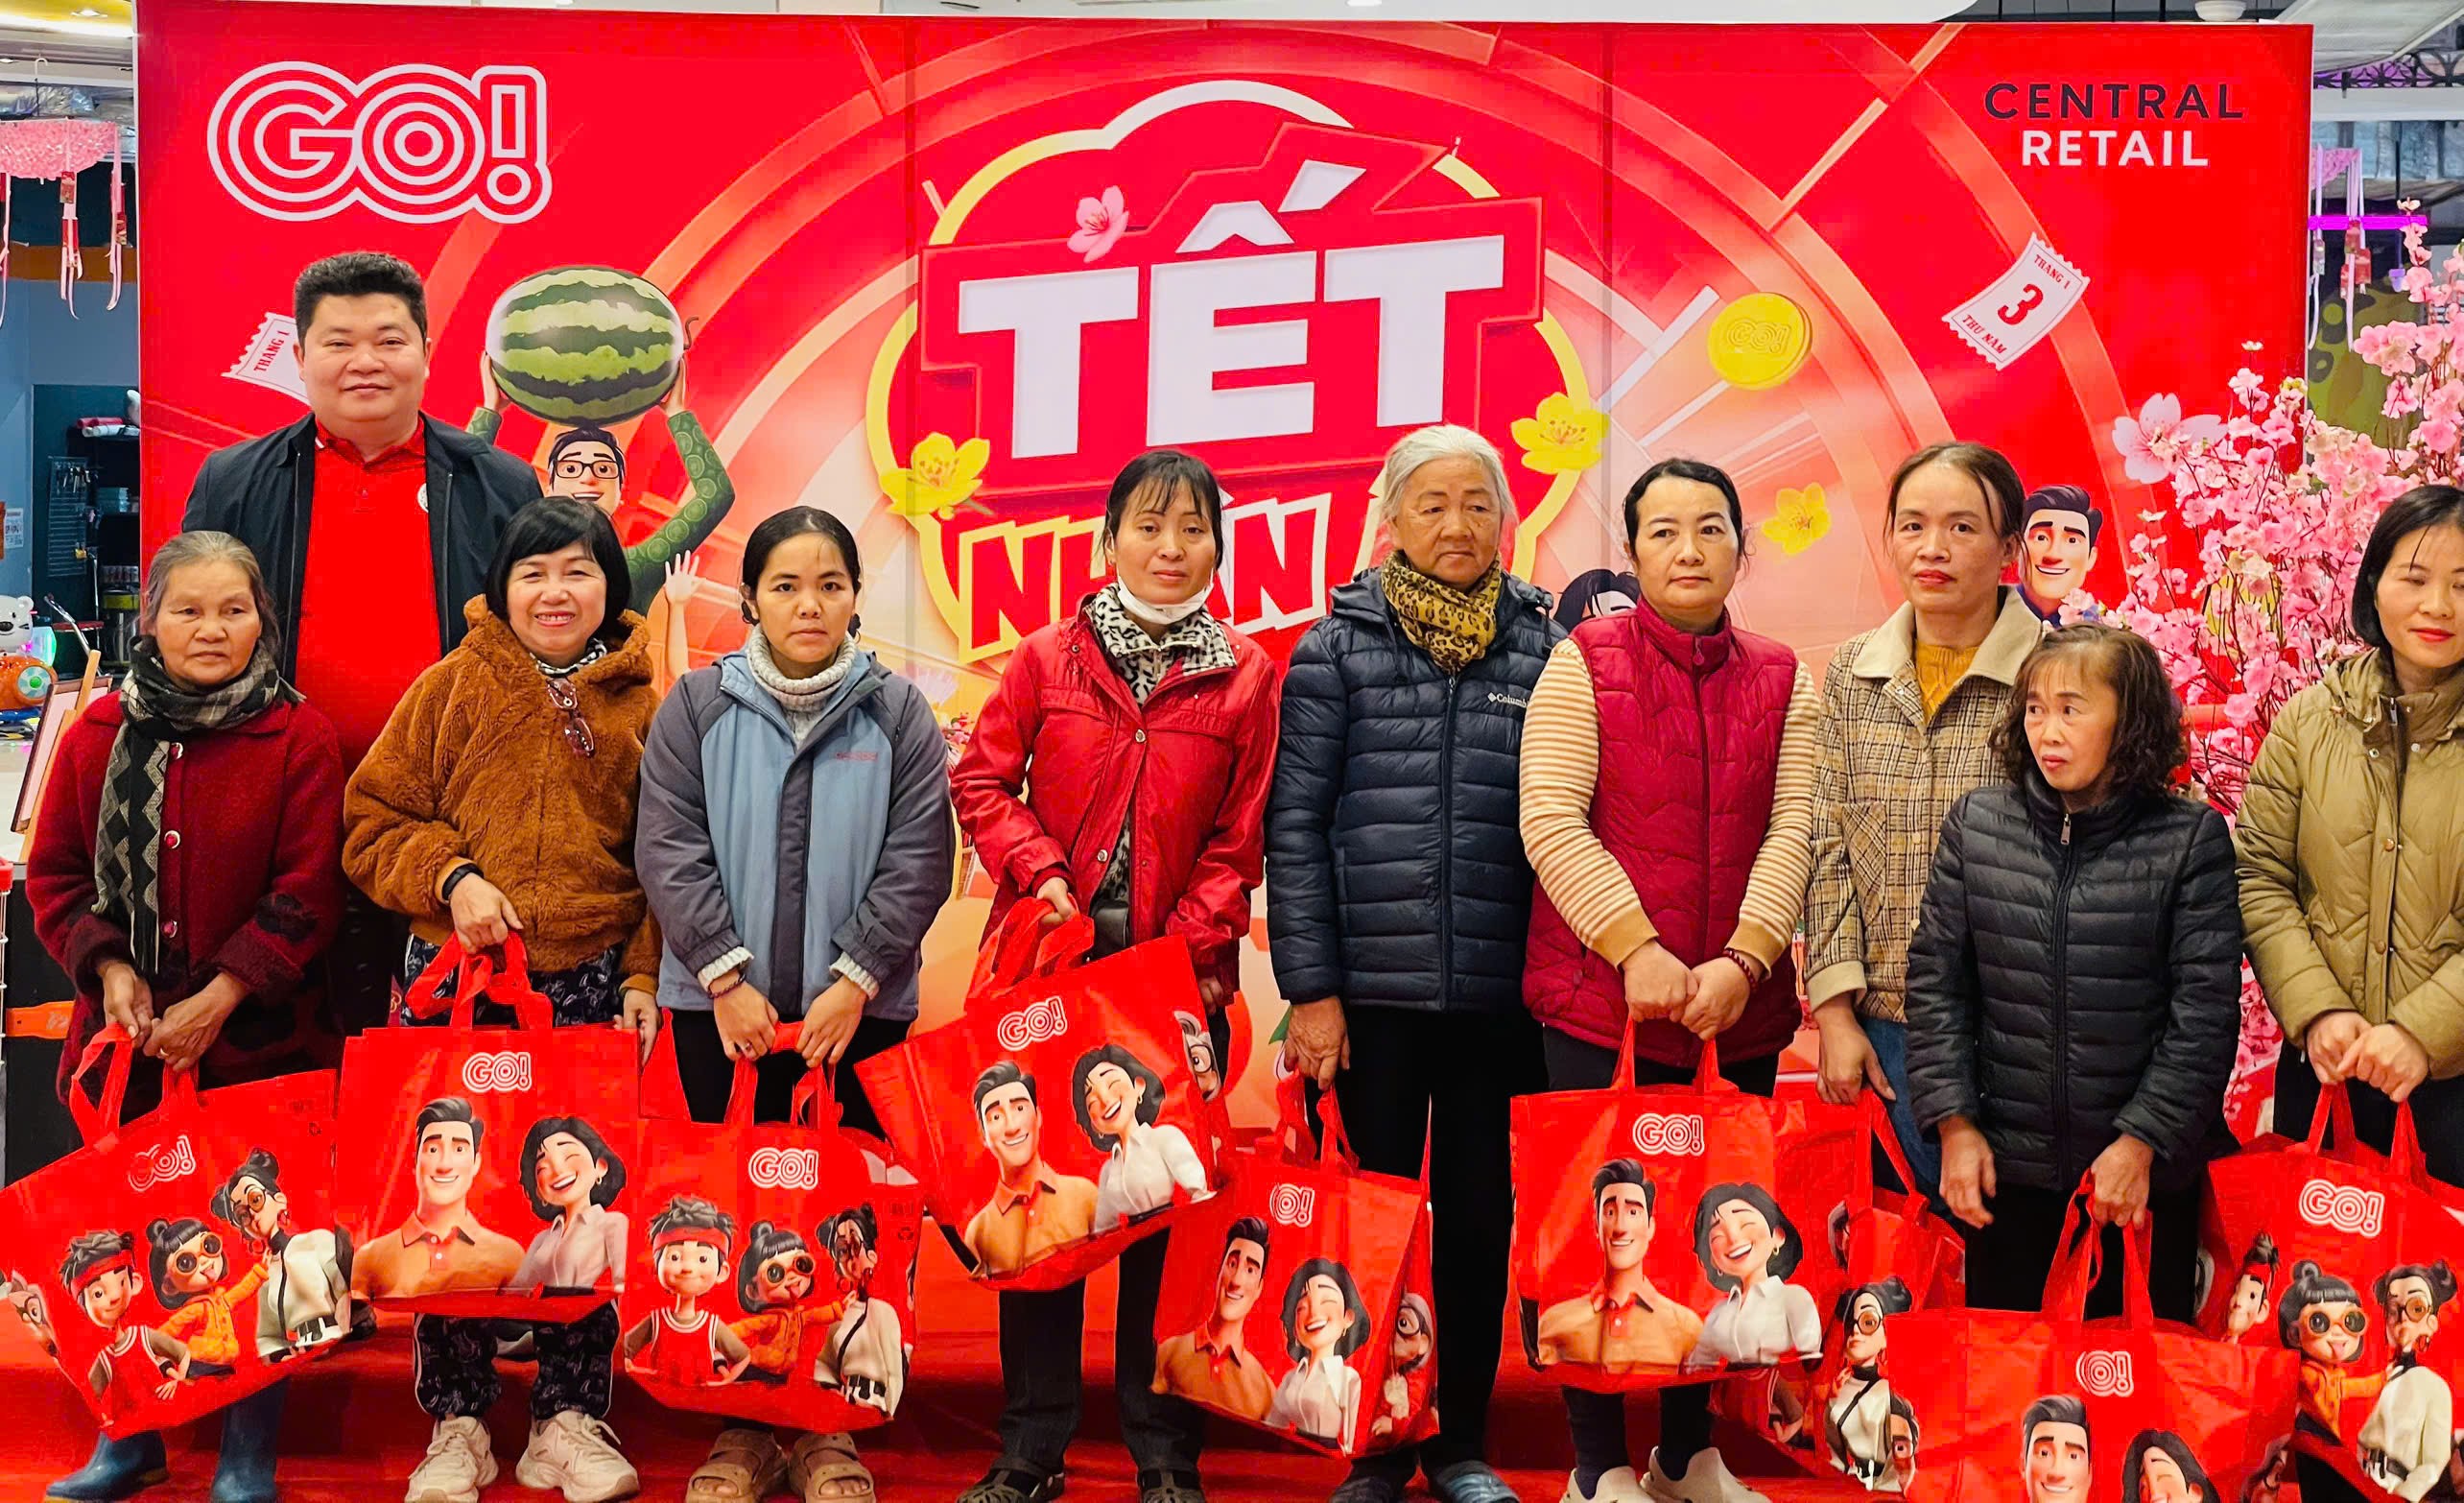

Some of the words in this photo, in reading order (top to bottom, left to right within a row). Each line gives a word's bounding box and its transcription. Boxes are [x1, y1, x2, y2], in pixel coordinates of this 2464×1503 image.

[1984, 83, 2243, 119] CENTRAL
[207, 60, 552, 224] GO!
[2022, 130, 2210, 167] RETAIL
[959, 159, 1504, 460] TẾT
[1997, 283, 2044, 325] 3
[960, 486, 1332, 664] NHN
[1497, 692, 1530, 709] Columb
[997, 995, 1068, 1052] GO!
[462, 1050, 533, 1093] GO!
[1632, 1112, 1705, 1157] GO!
[748, 1147, 818, 1191] GO!
[1268, 1182, 1315, 1229] O!
[2299, 1179, 2385, 1238] GO!
